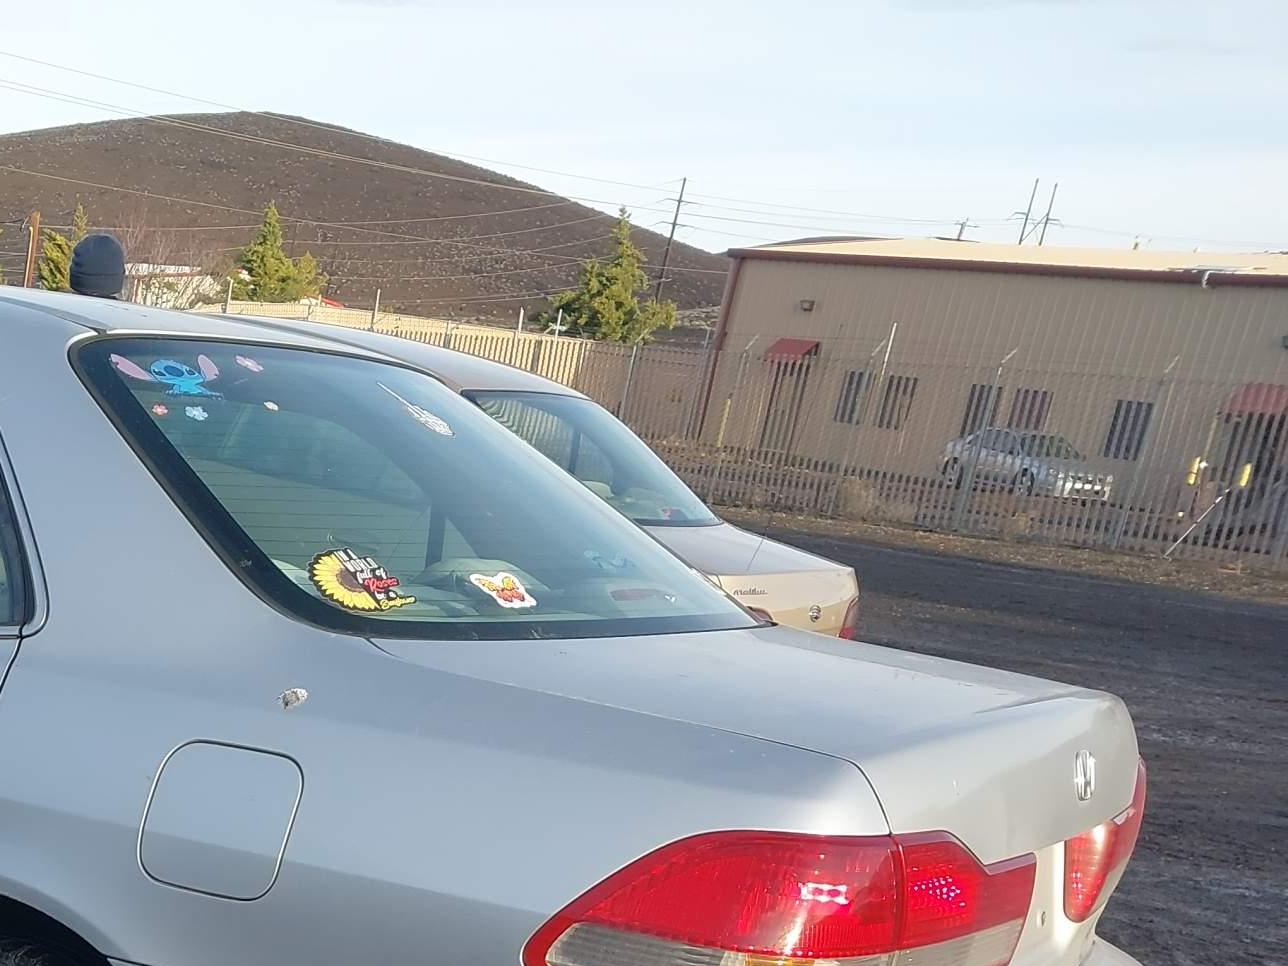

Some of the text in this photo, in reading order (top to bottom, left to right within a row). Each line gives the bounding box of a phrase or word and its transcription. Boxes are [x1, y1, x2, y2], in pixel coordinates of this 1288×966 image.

[342, 557, 378, 572] WORLD
[356, 567, 387, 584] full of
[364, 578, 398, 592] Roses
